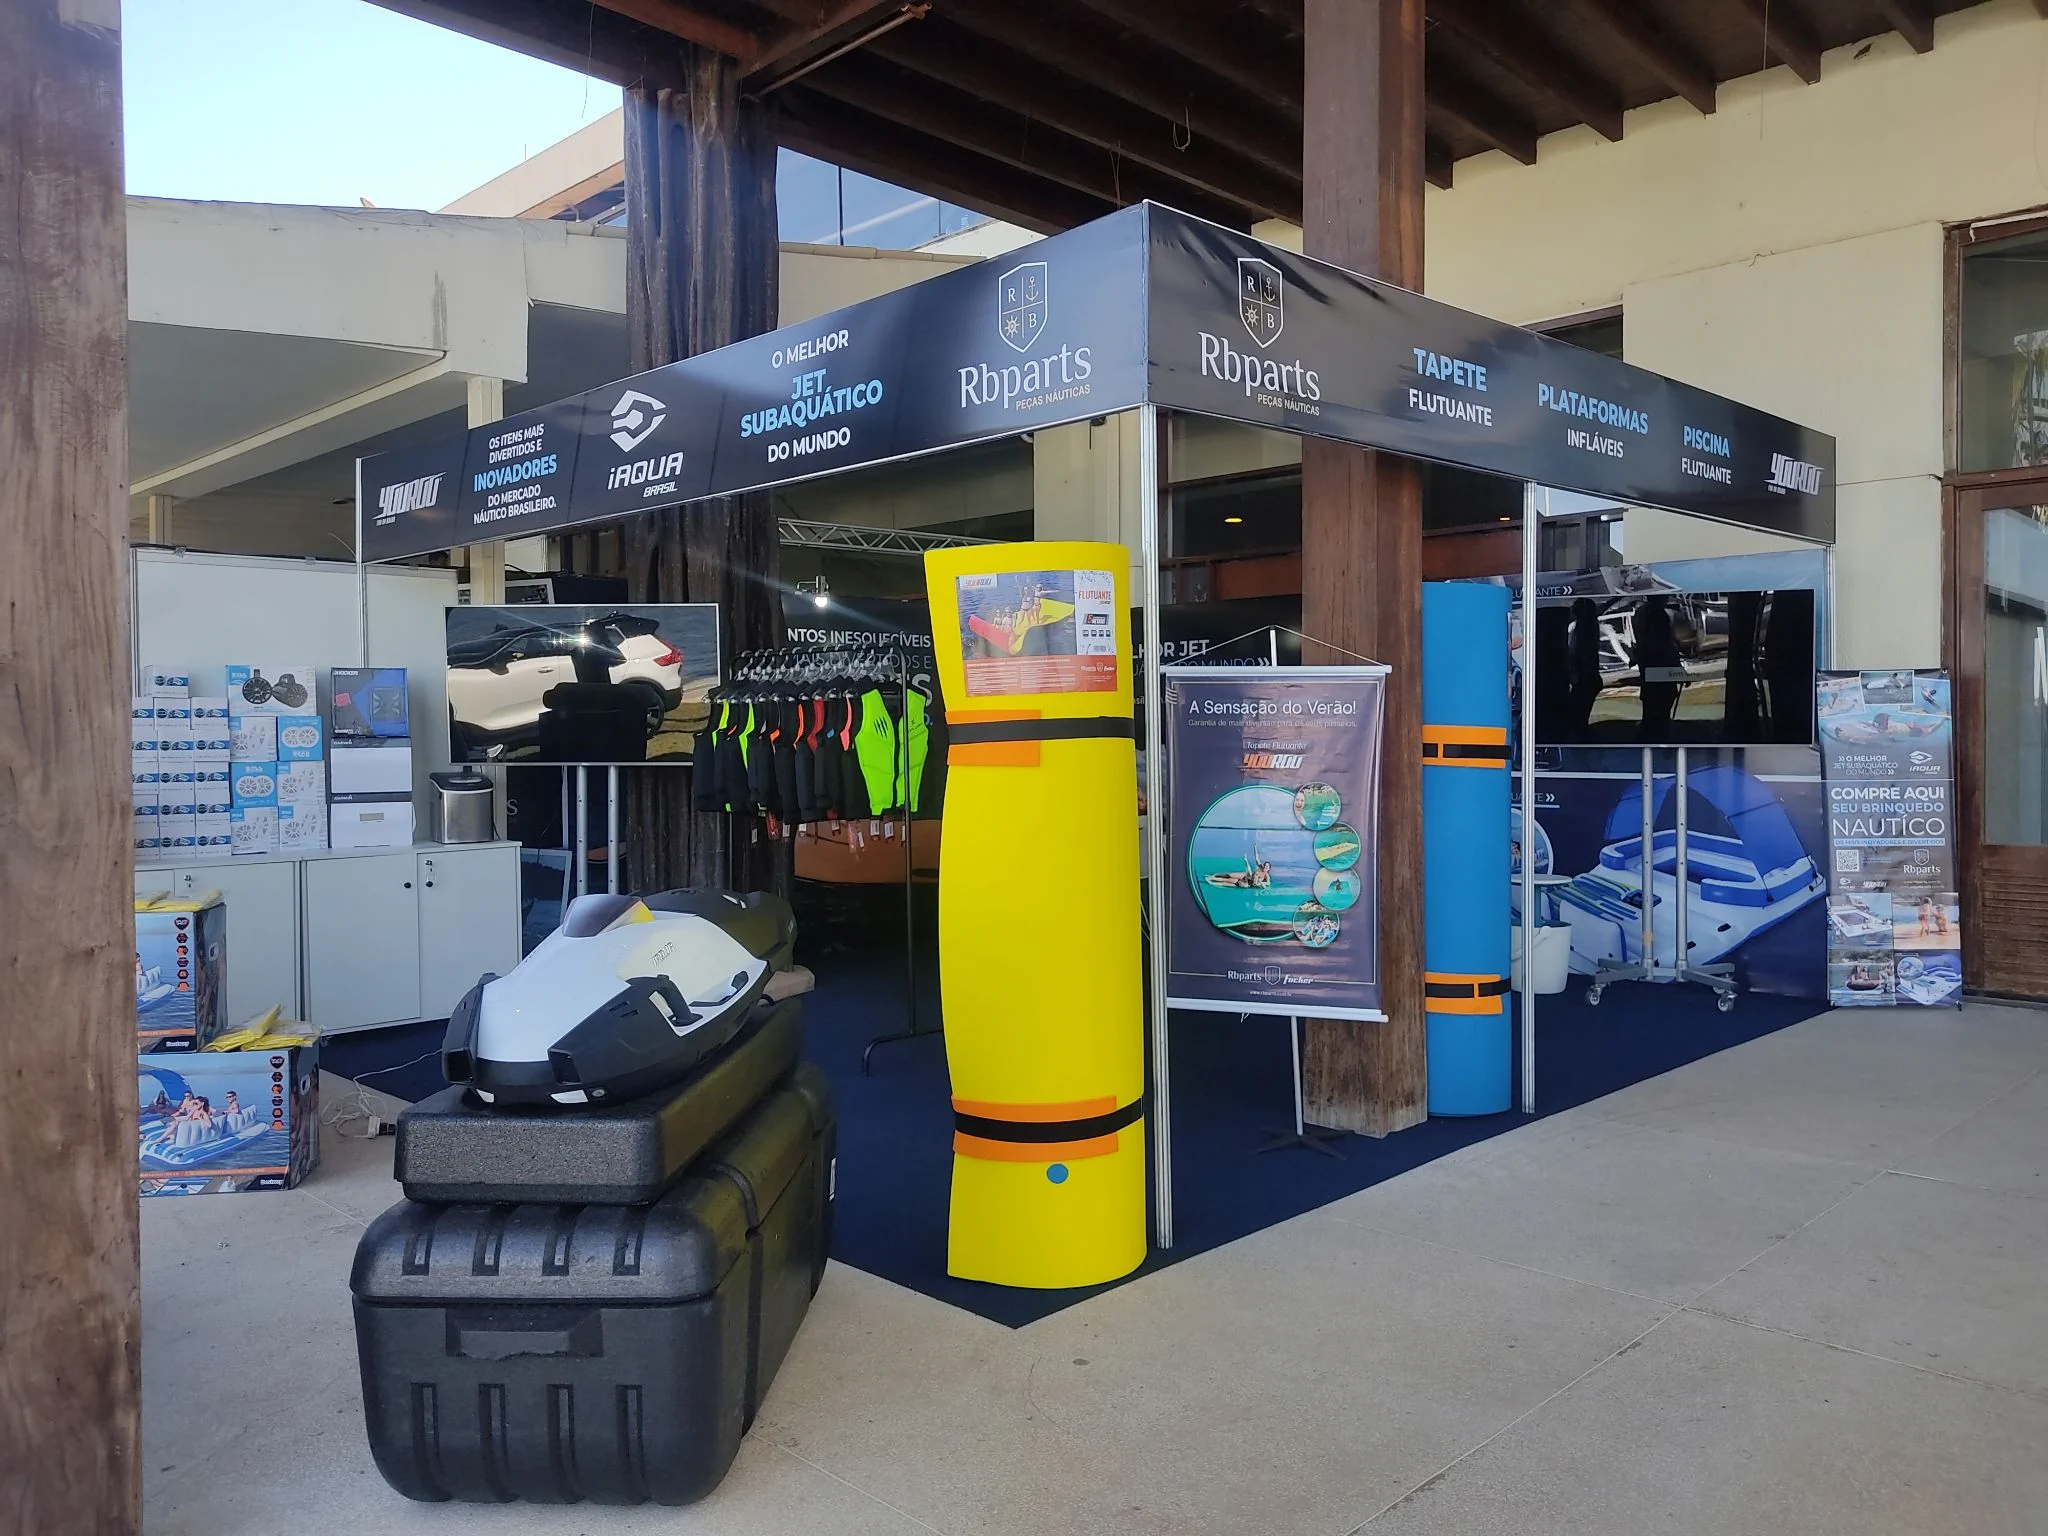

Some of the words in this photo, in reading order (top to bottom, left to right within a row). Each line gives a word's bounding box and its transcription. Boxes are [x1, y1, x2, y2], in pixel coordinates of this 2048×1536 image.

[771, 350, 784, 369] O
[786, 328, 849, 365] MELHOR
[957, 342, 1093, 410] Rbparts
[1198, 331, 1322, 401] Rbparts
[1413, 348, 1487, 392] TAPETE
[791, 367, 827, 401] JET
[1015, 394, 1044, 411] PEÇAS
[1045, 383, 1091, 405] NÁUTICAS
[740, 378, 884, 438] SUBAQUÁTICO
[1257, 393, 1283, 410] PEÇAS
[1283, 399, 1320, 417] NÁUTICAS
[1409, 388, 1492, 427] FLUTUANTE
[1538, 382, 1648, 434] PLATAFORMAS
[489, 434, 500, 449] OS
[501, 428, 522, 447] ITENS
[523, 423, 545, 442] MAIS
[767, 442, 791, 463] DO
[792, 426, 851, 457] MUNDO
[1567, 427, 1624, 458] INFLÁVEIS
[1683, 426, 1730, 458] PISCINA
[488, 444, 534, 464] DIVERTIDOS
[536, 441, 542, 452] E
[473, 453, 558, 493] INOVADORES
[1681, 457, 1731, 484] FLUTUANTE
[487, 494, 500, 508] DO
[501, 484, 541, 505] MERCADO
[642, 481, 678, 498] BRASIL
[473, 506, 506, 525] NÁUTICO
[508, 495, 557, 518] BRASILEIRO.
[1079, 590, 1112, 600] FLUTUANTE
[1179, 639, 1209, 657] JET
[1189, 701, 1199, 714] A
[1204, 700, 1277, 717] Sensação
[1283, 700, 1301, 714] do
[1308, 700, 1357, 714] Verão!
[1831, 788, 1900, 800] COMPRE
[1904, 787, 1944, 801] AQUI
[1832, 804, 1858, 813] SEU
[1862, 803, 1944, 814] BRINQUEDO
[1833, 814, 1945, 836] NAUTÍCO
[1903, 865, 1941, 875] Rbparts
[1228, 971, 1262, 982] Rbparts
